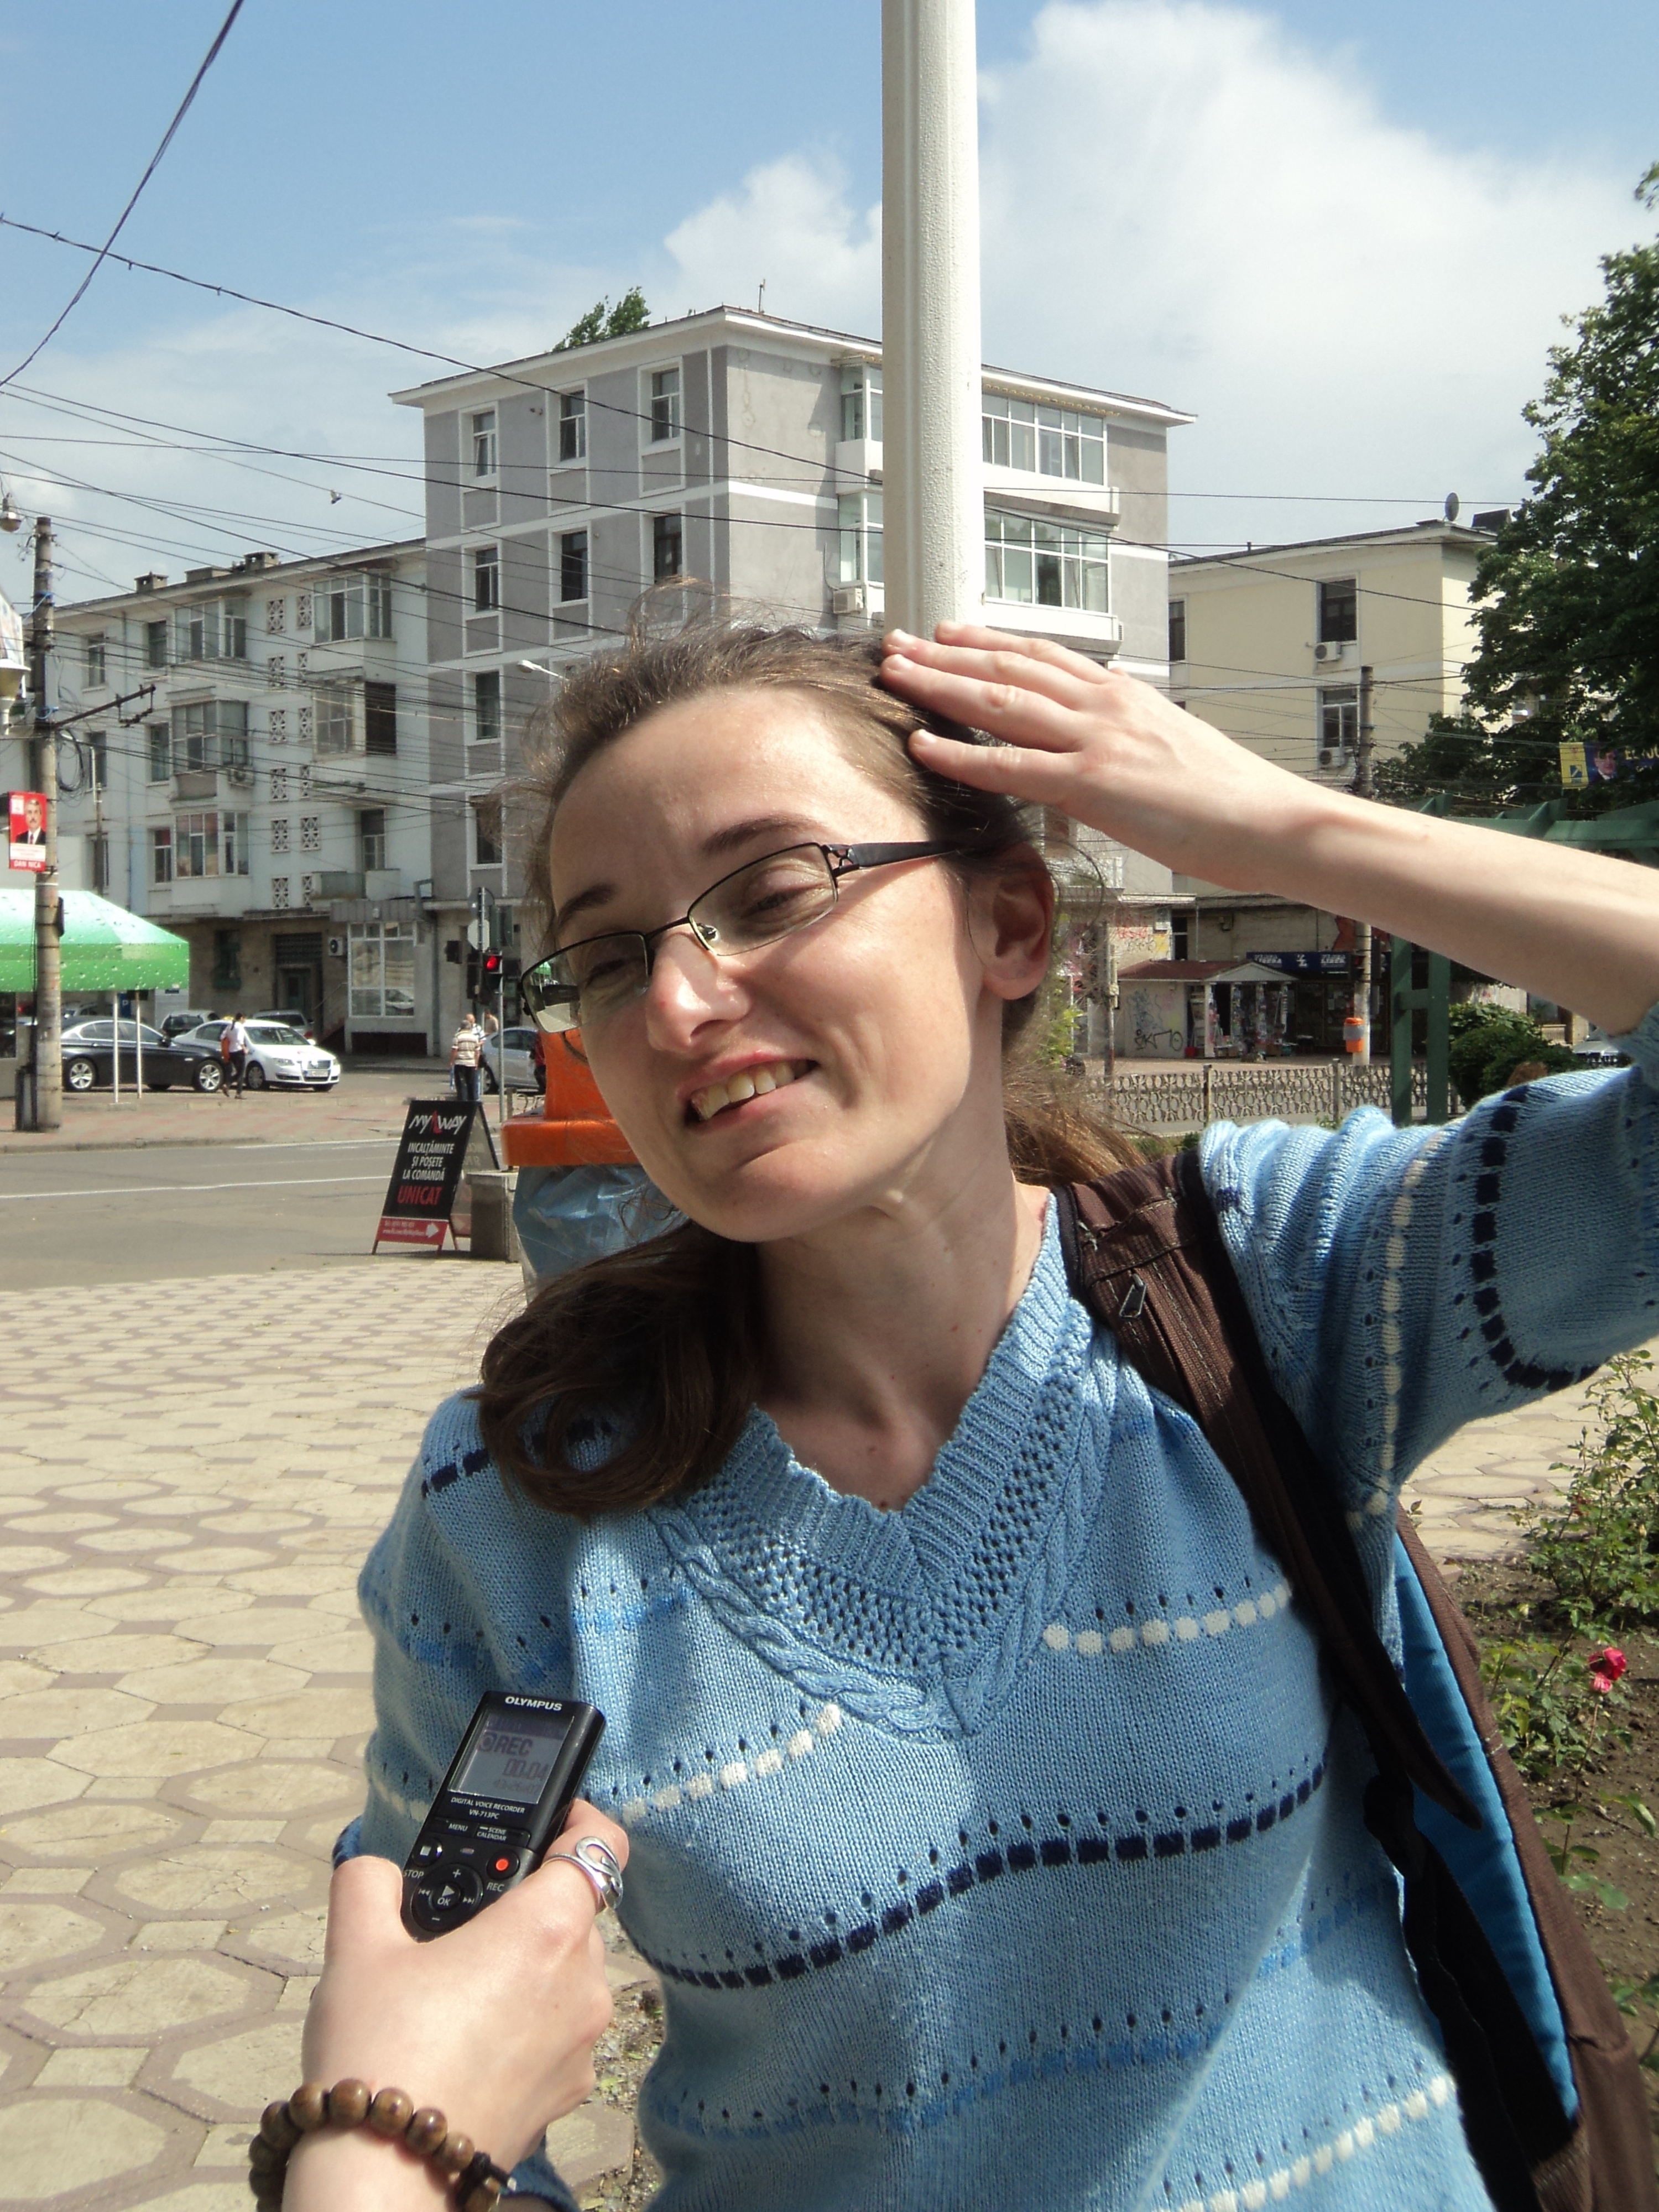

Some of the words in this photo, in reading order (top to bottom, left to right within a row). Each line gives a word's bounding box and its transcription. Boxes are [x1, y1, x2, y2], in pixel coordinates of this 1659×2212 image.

[408, 1115, 433, 1134] MY
[437, 1115, 467, 1135] WAY
[402, 1170, 410, 1180] LA
[398, 1186, 442, 1205] UNICAT
[505, 1696, 562, 1711] OLYMPUS
[494, 1735, 533, 1756] REC
[451, 1797, 473, 1806] DIGITAL
[493, 1803, 525, 1814] RECORDER
[469, 1809, 500, 1819] VN-713PC
[448, 1823, 468, 1832] MENU
[488, 1827, 507, 1835] SCENE
[477, 1832, 507, 1841] CALENDAR
[404, 1869, 424, 1879] STOP
[487, 1882, 505, 1892] REC
[437, 1897, 451, 1906] OK
